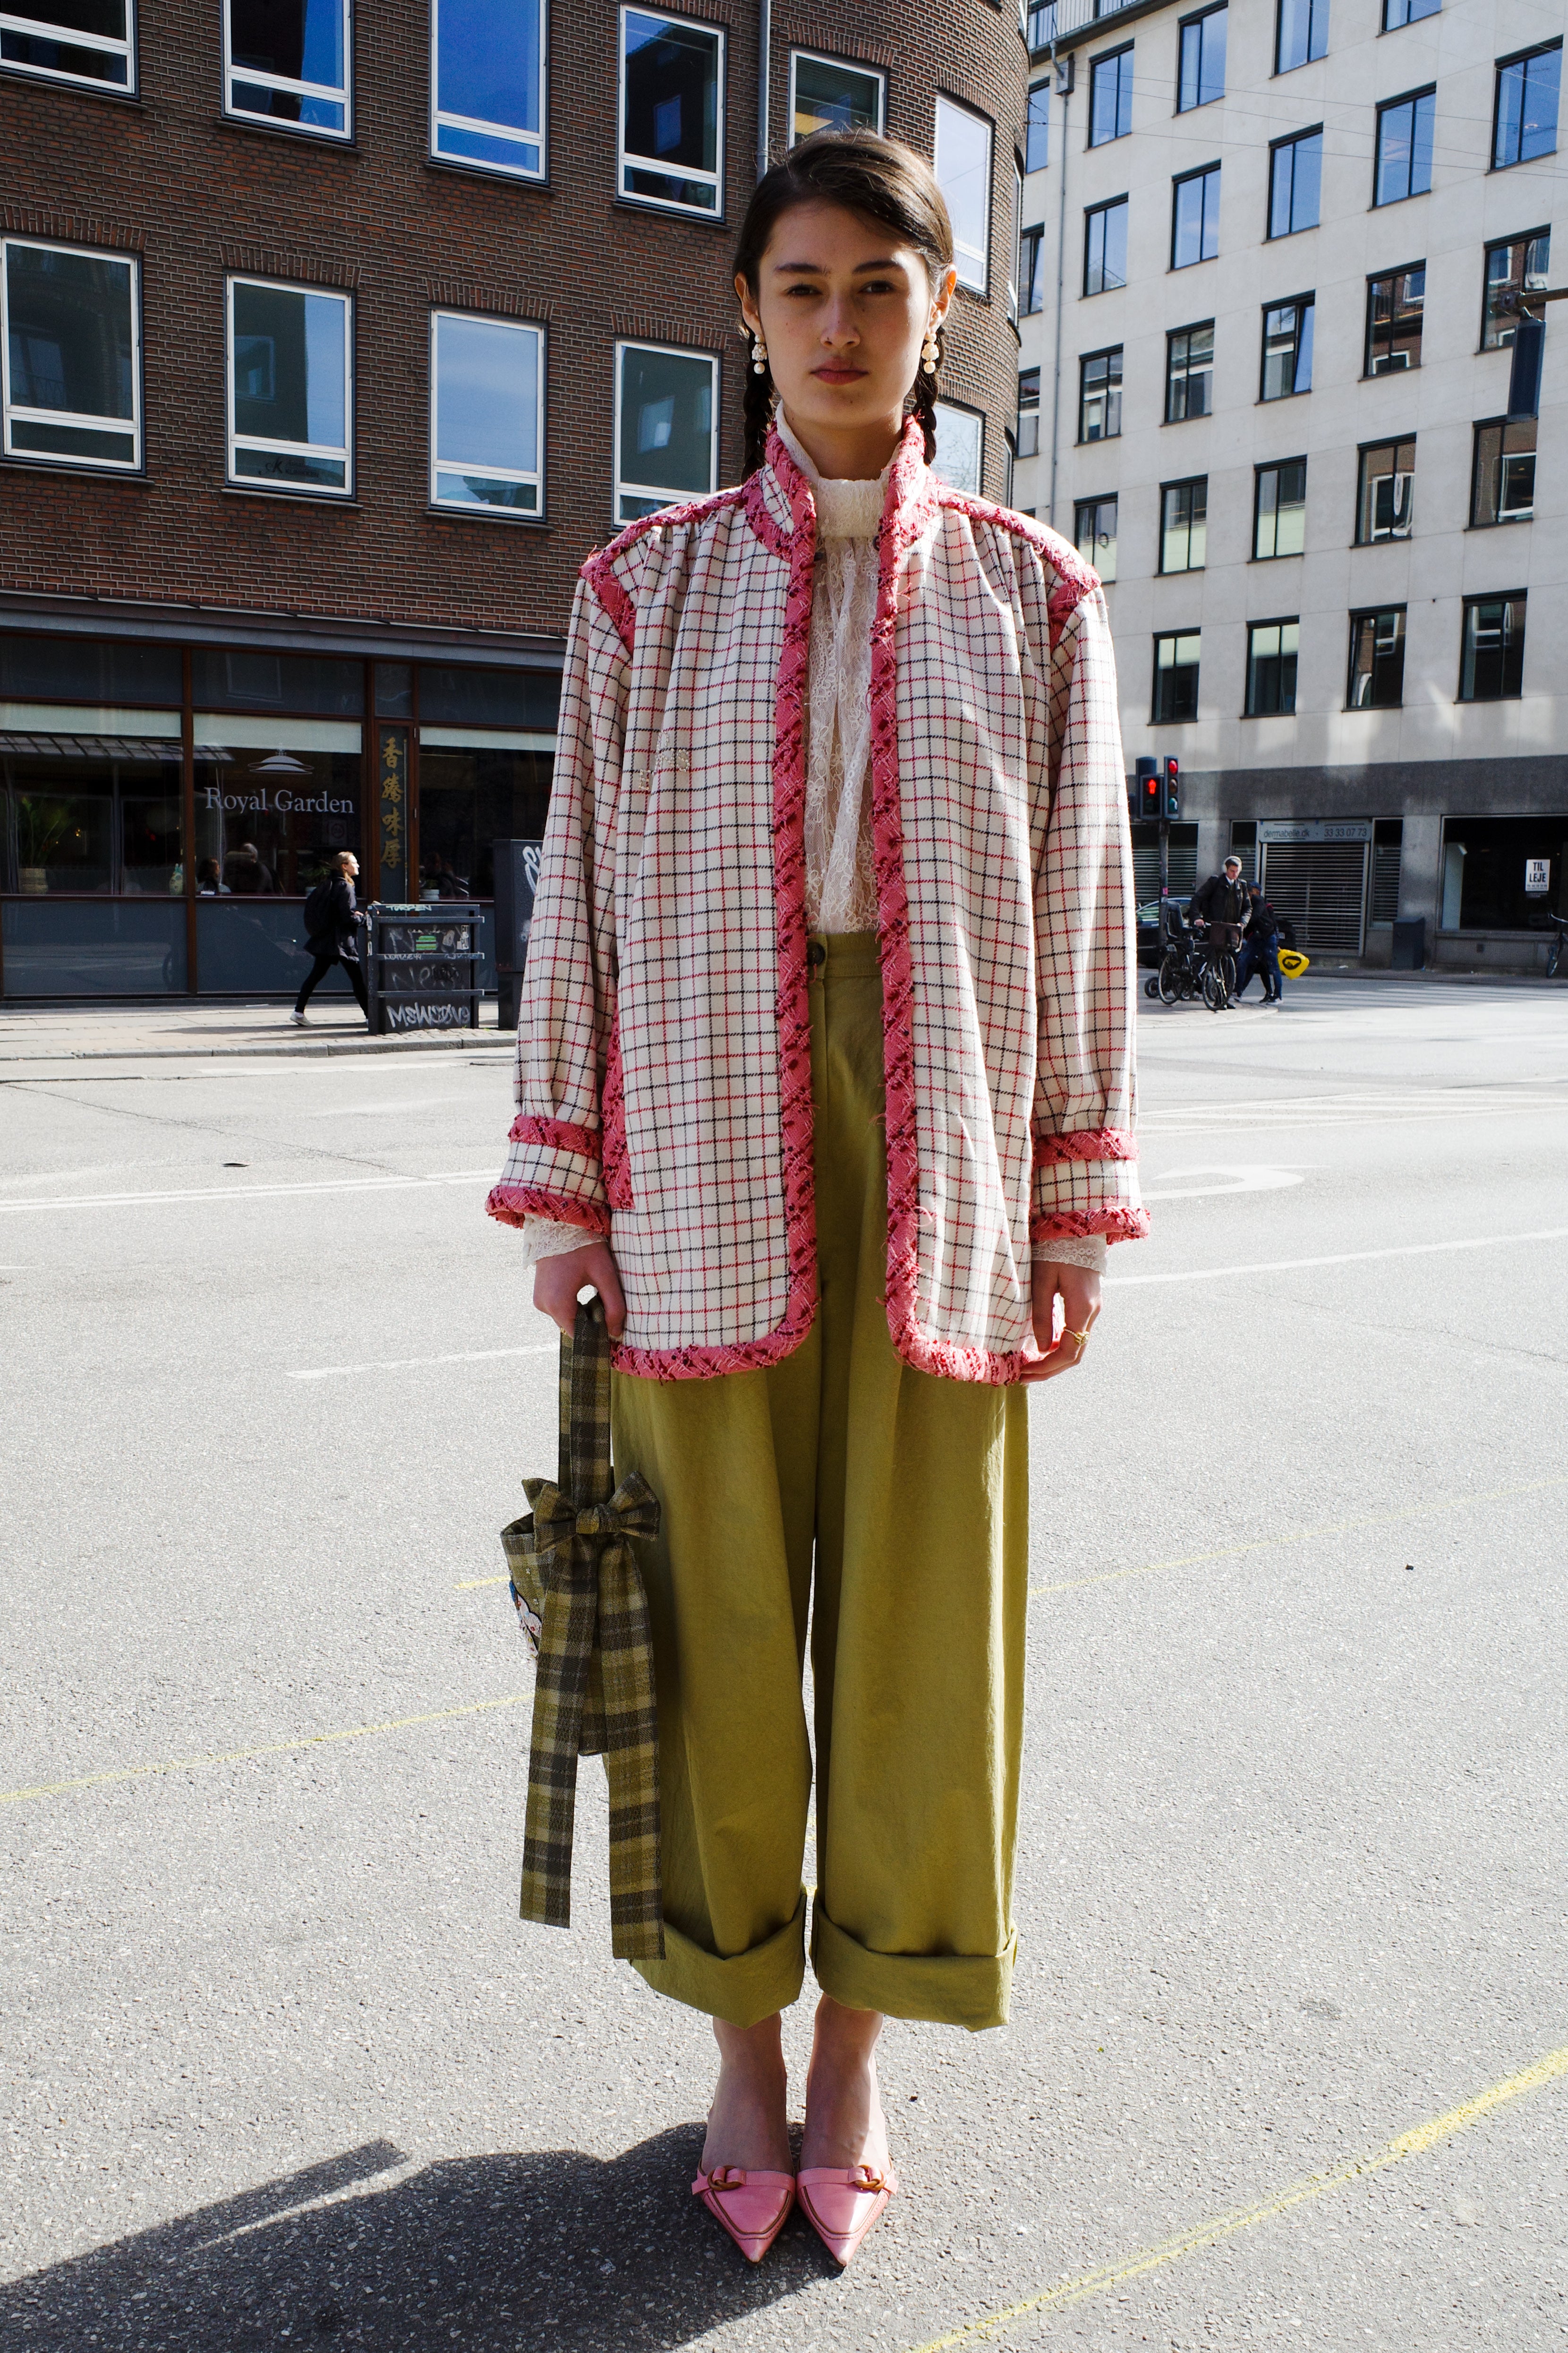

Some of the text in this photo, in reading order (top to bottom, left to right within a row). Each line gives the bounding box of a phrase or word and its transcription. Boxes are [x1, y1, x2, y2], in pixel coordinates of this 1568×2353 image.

[204, 787, 354, 814] Royal Garden
[1264, 828, 1367, 838] dermabelle.dk 33 33 07 73
[1533, 862, 1543, 871] TIL
[1529, 873, 1546, 882] LEJE
